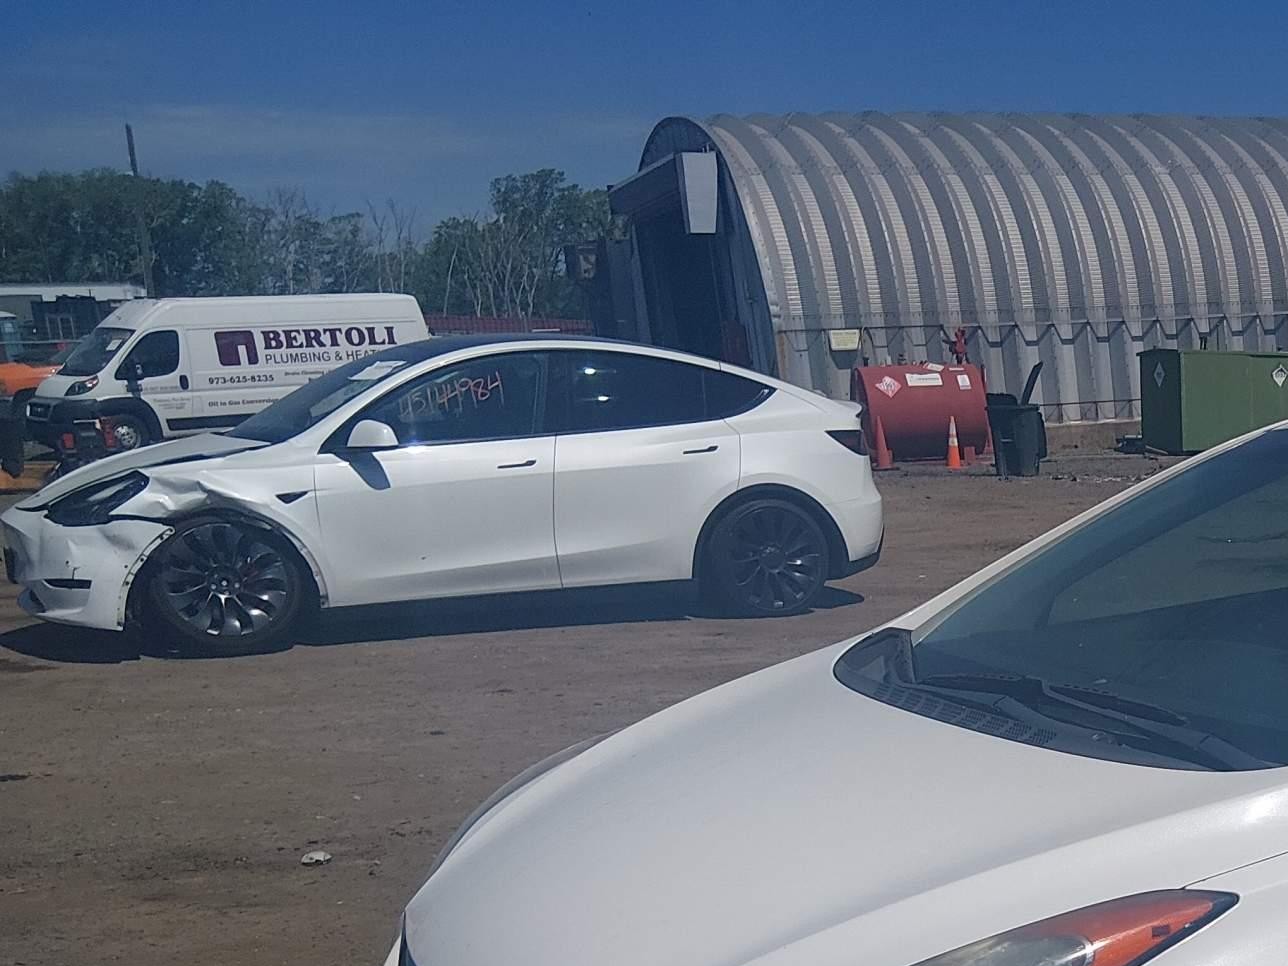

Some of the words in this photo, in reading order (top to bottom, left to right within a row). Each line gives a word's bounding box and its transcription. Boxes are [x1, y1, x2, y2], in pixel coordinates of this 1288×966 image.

[261, 326, 397, 350] BERTOLI
[265, 351, 331, 365] PLUMBING
[334, 351, 342, 361] &
[208, 374, 274, 385] 973-625-8235
[399, 371, 504, 418] 45144984
